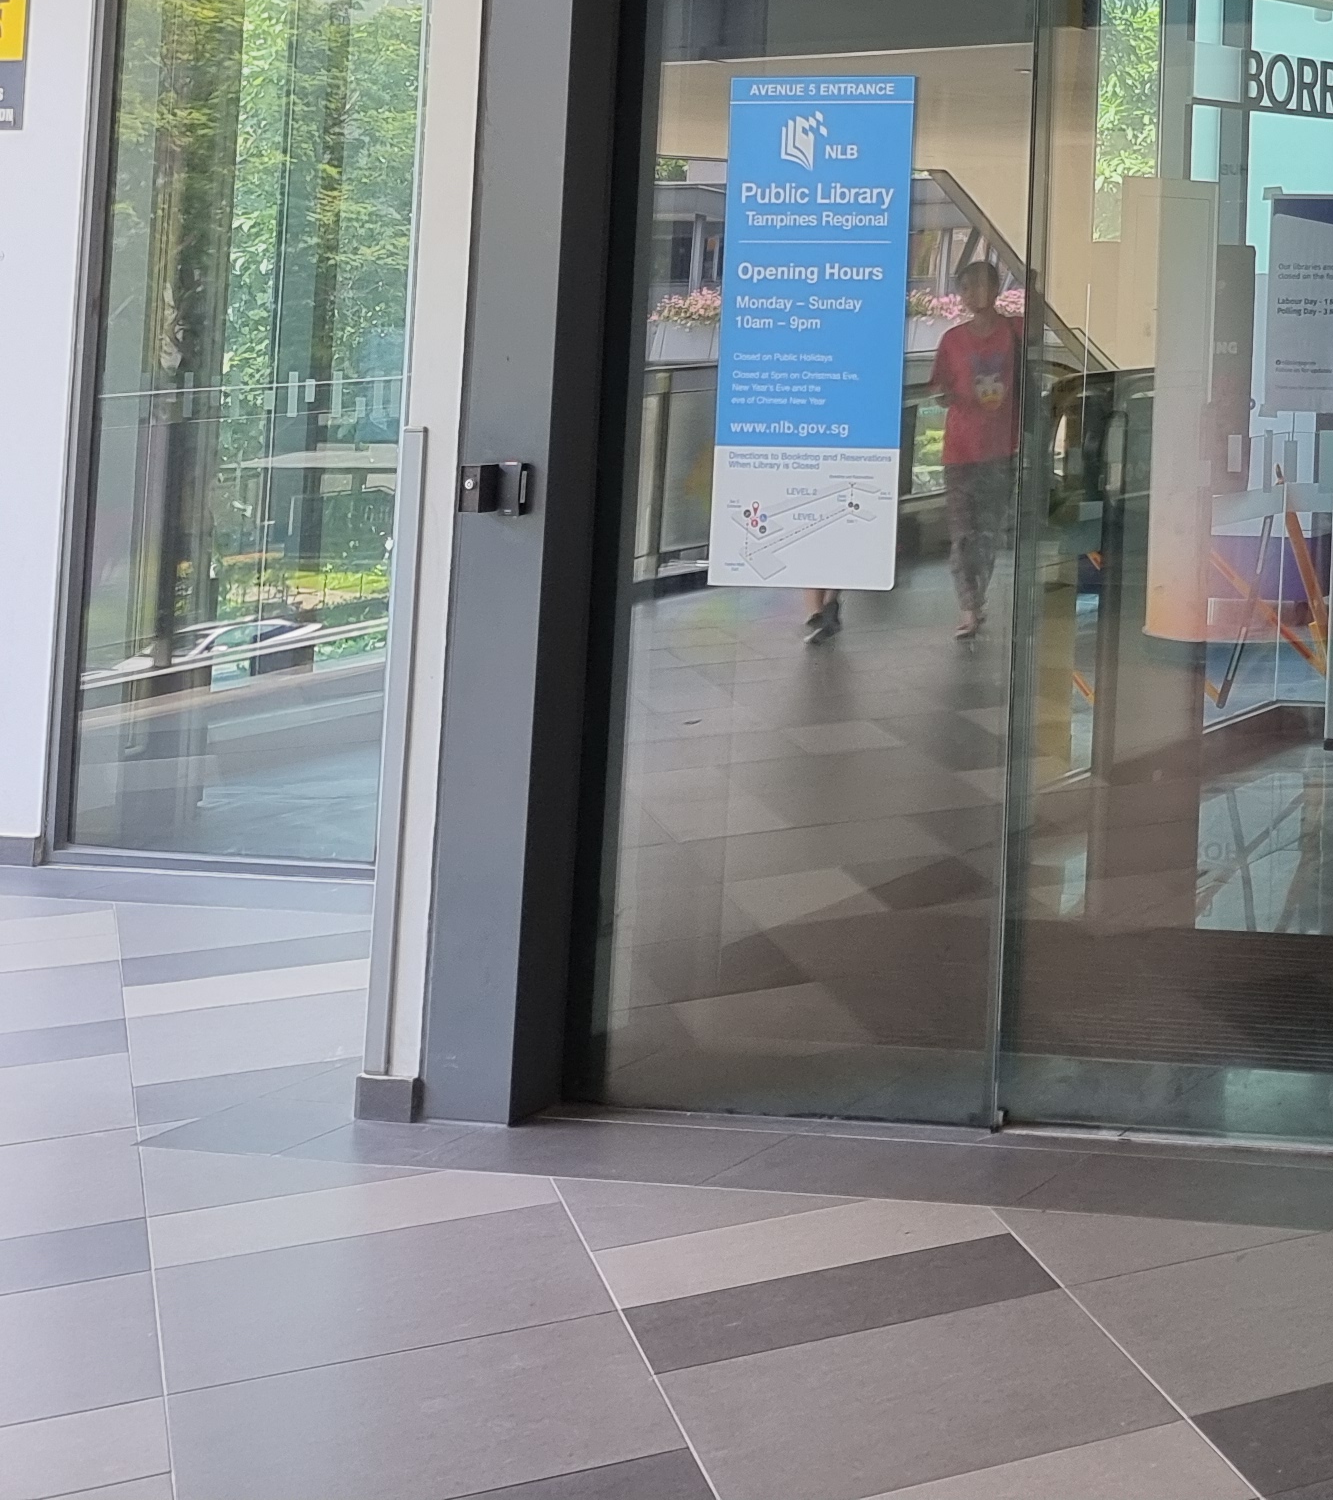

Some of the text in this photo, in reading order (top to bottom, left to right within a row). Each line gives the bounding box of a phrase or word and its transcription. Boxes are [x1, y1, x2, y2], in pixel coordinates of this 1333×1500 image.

[750, 83, 895, 96] AVENUE 5 ENTRANCE
[825, 145, 858, 159] NLB
[741, 183, 894, 209] Public Library
[746, 211, 888, 230] Tampines Regional
[737, 262, 883, 284] Opening Hours
[736, 296, 793, 313] Monday
[808, 296, 862, 313] Sunday
[1303, 298, 1318, 306] Day
[1277, 307, 1302, 316] Polling
[1303, 308, 1317, 316] Day
[736, 316, 773, 329] 10am
[789, 316, 820, 332] 9pm
[733, 353, 761, 361] Closed
[774, 353, 798, 361] Public
[800, 353, 833, 363] Holidays
[732, 371, 760, 379] Closed
[771, 371, 788, 381] 5pm
[801, 371, 841, 380] Christmas
[732, 384, 750, 392] New
[775, 384, 790, 392] Eve
[756, 397, 787, 405] Chinese
[789, 397, 807, 405] New
[808, 397, 826, 405] Year
[730, 420, 849, 438] www.nlb.gov.sg
[728, 452, 769, 461] Directions
[781, 453, 820, 462] Bookdrop
[839, 454, 892, 462] Reservations
[753, 461, 781, 470] Library
[791, 462, 820, 470] Closed
[786, 488, 809, 496] LEVEL
[793, 513, 818, 521] LEVEL
